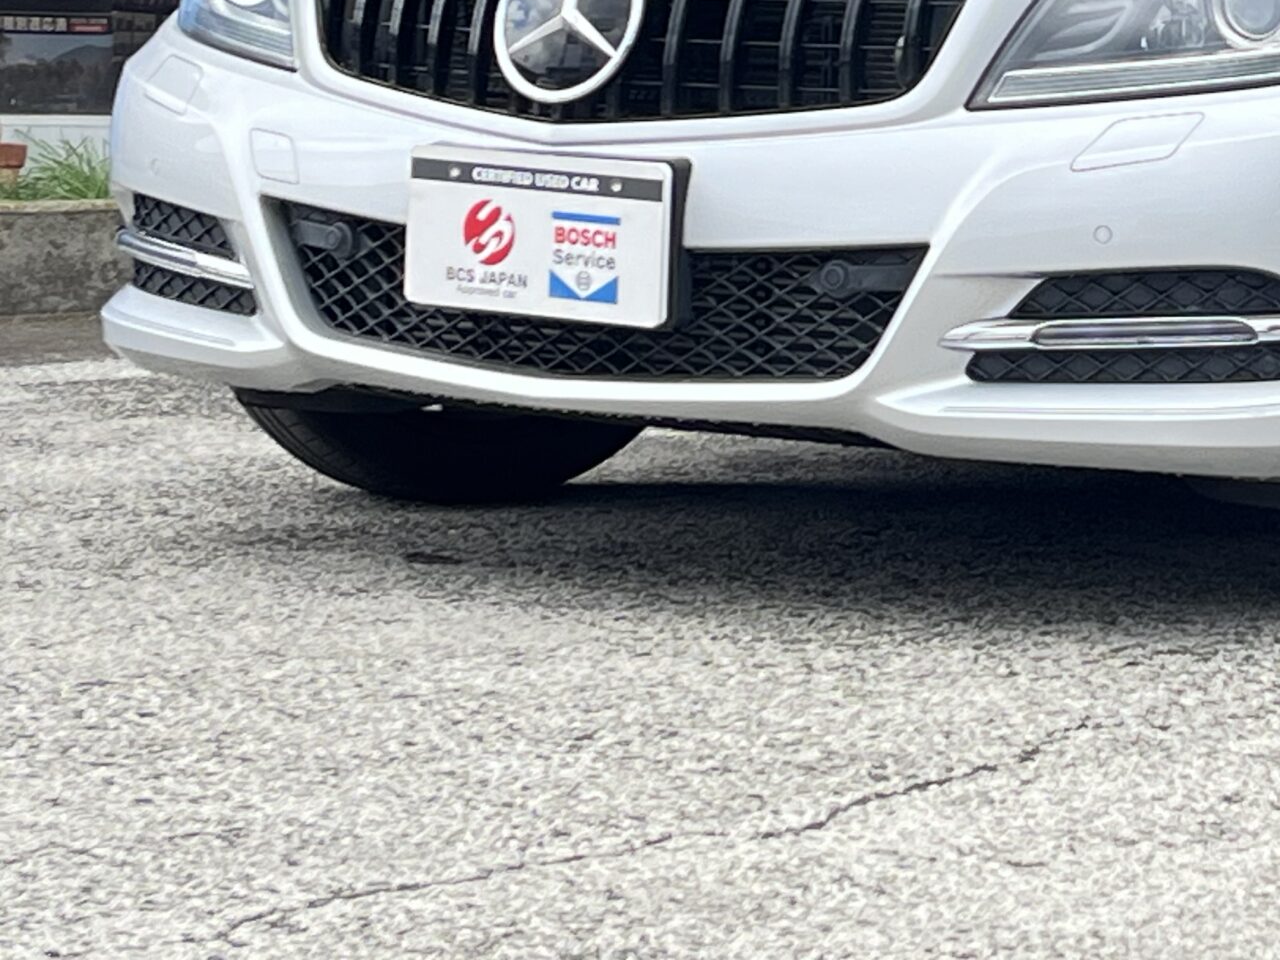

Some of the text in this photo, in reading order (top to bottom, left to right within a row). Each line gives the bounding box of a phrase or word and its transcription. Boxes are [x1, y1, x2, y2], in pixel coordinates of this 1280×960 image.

[534, 172, 570, 189] USED
[570, 176, 600, 192] CAR
[554, 226, 617, 249] BOSCH
[552, 248, 617, 270] Service
[446, 266, 529, 288] BCS JAPAN
